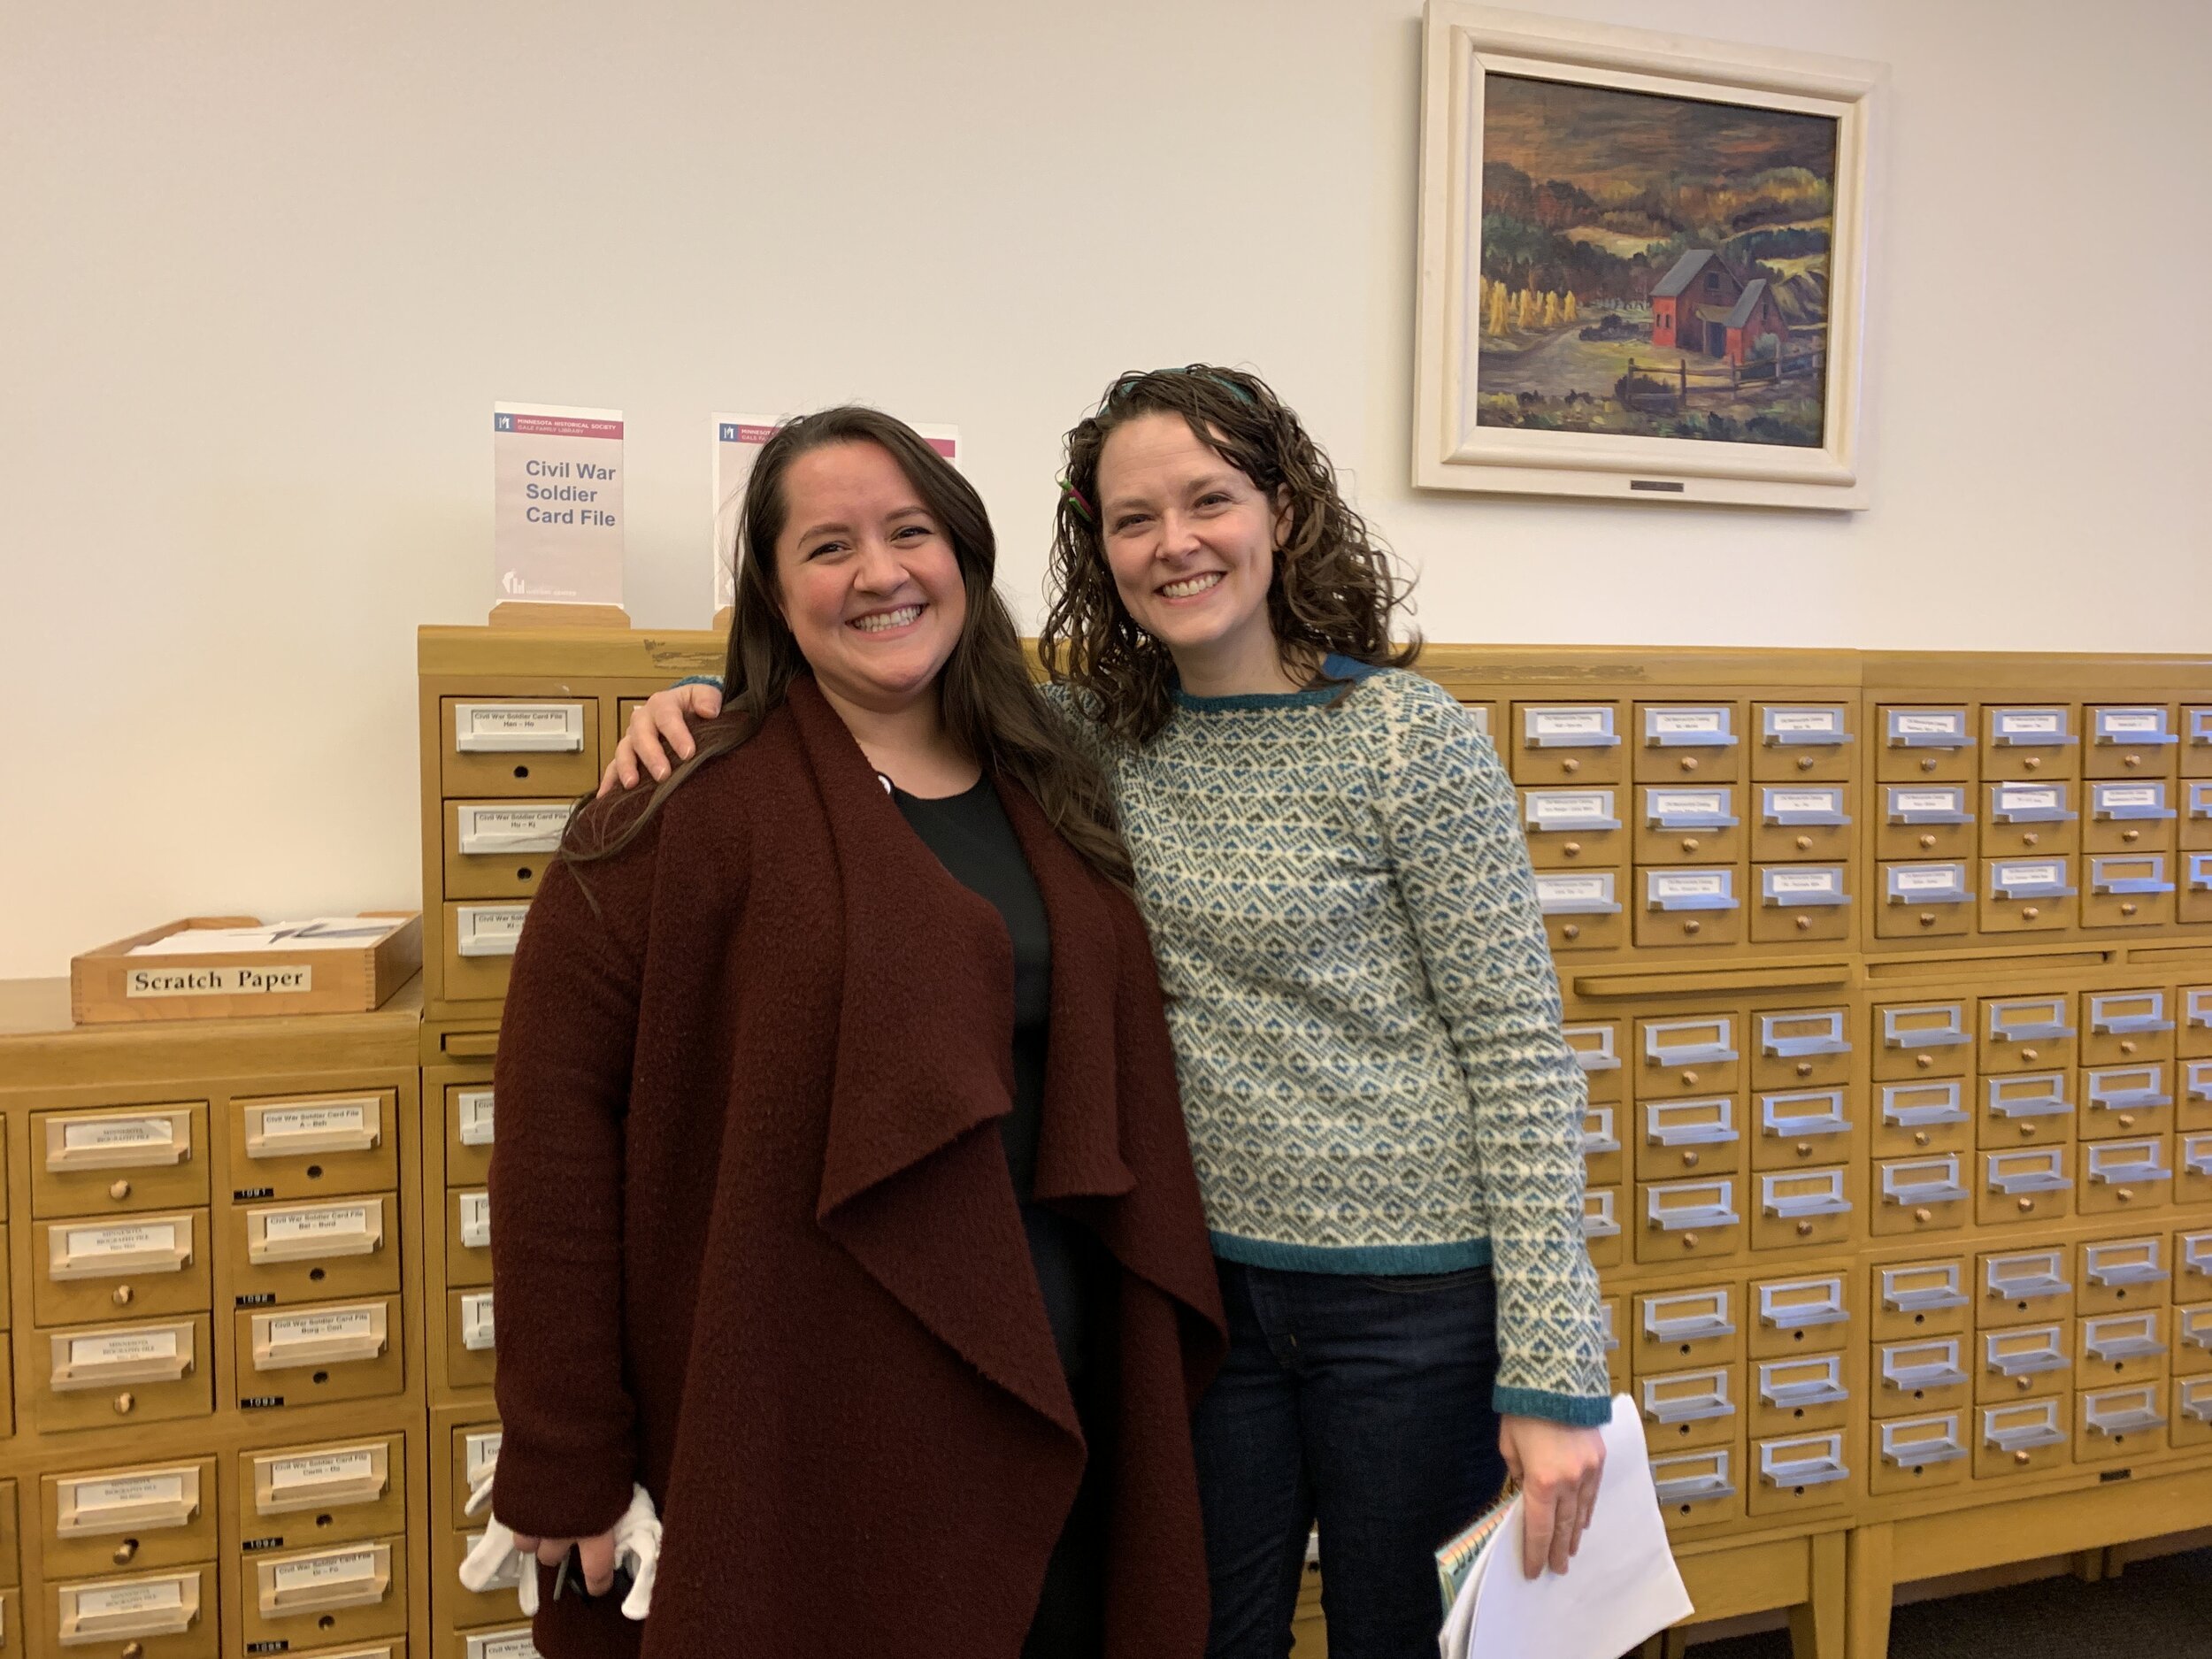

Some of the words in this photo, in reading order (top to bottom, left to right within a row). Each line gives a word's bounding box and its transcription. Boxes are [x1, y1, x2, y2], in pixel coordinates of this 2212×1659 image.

[554, 420, 589, 429] HISTORICAL
[526, 460, 570, 478] Civil
[576, 463, 617, 480] War
[526, 483, 598, 502] Soldier
[526, 506, 573, 525] Card
[580, 510, 616, 526] File
[134, 972, 222, 992] Scratch
[238, 970, 303, 992] Paper
